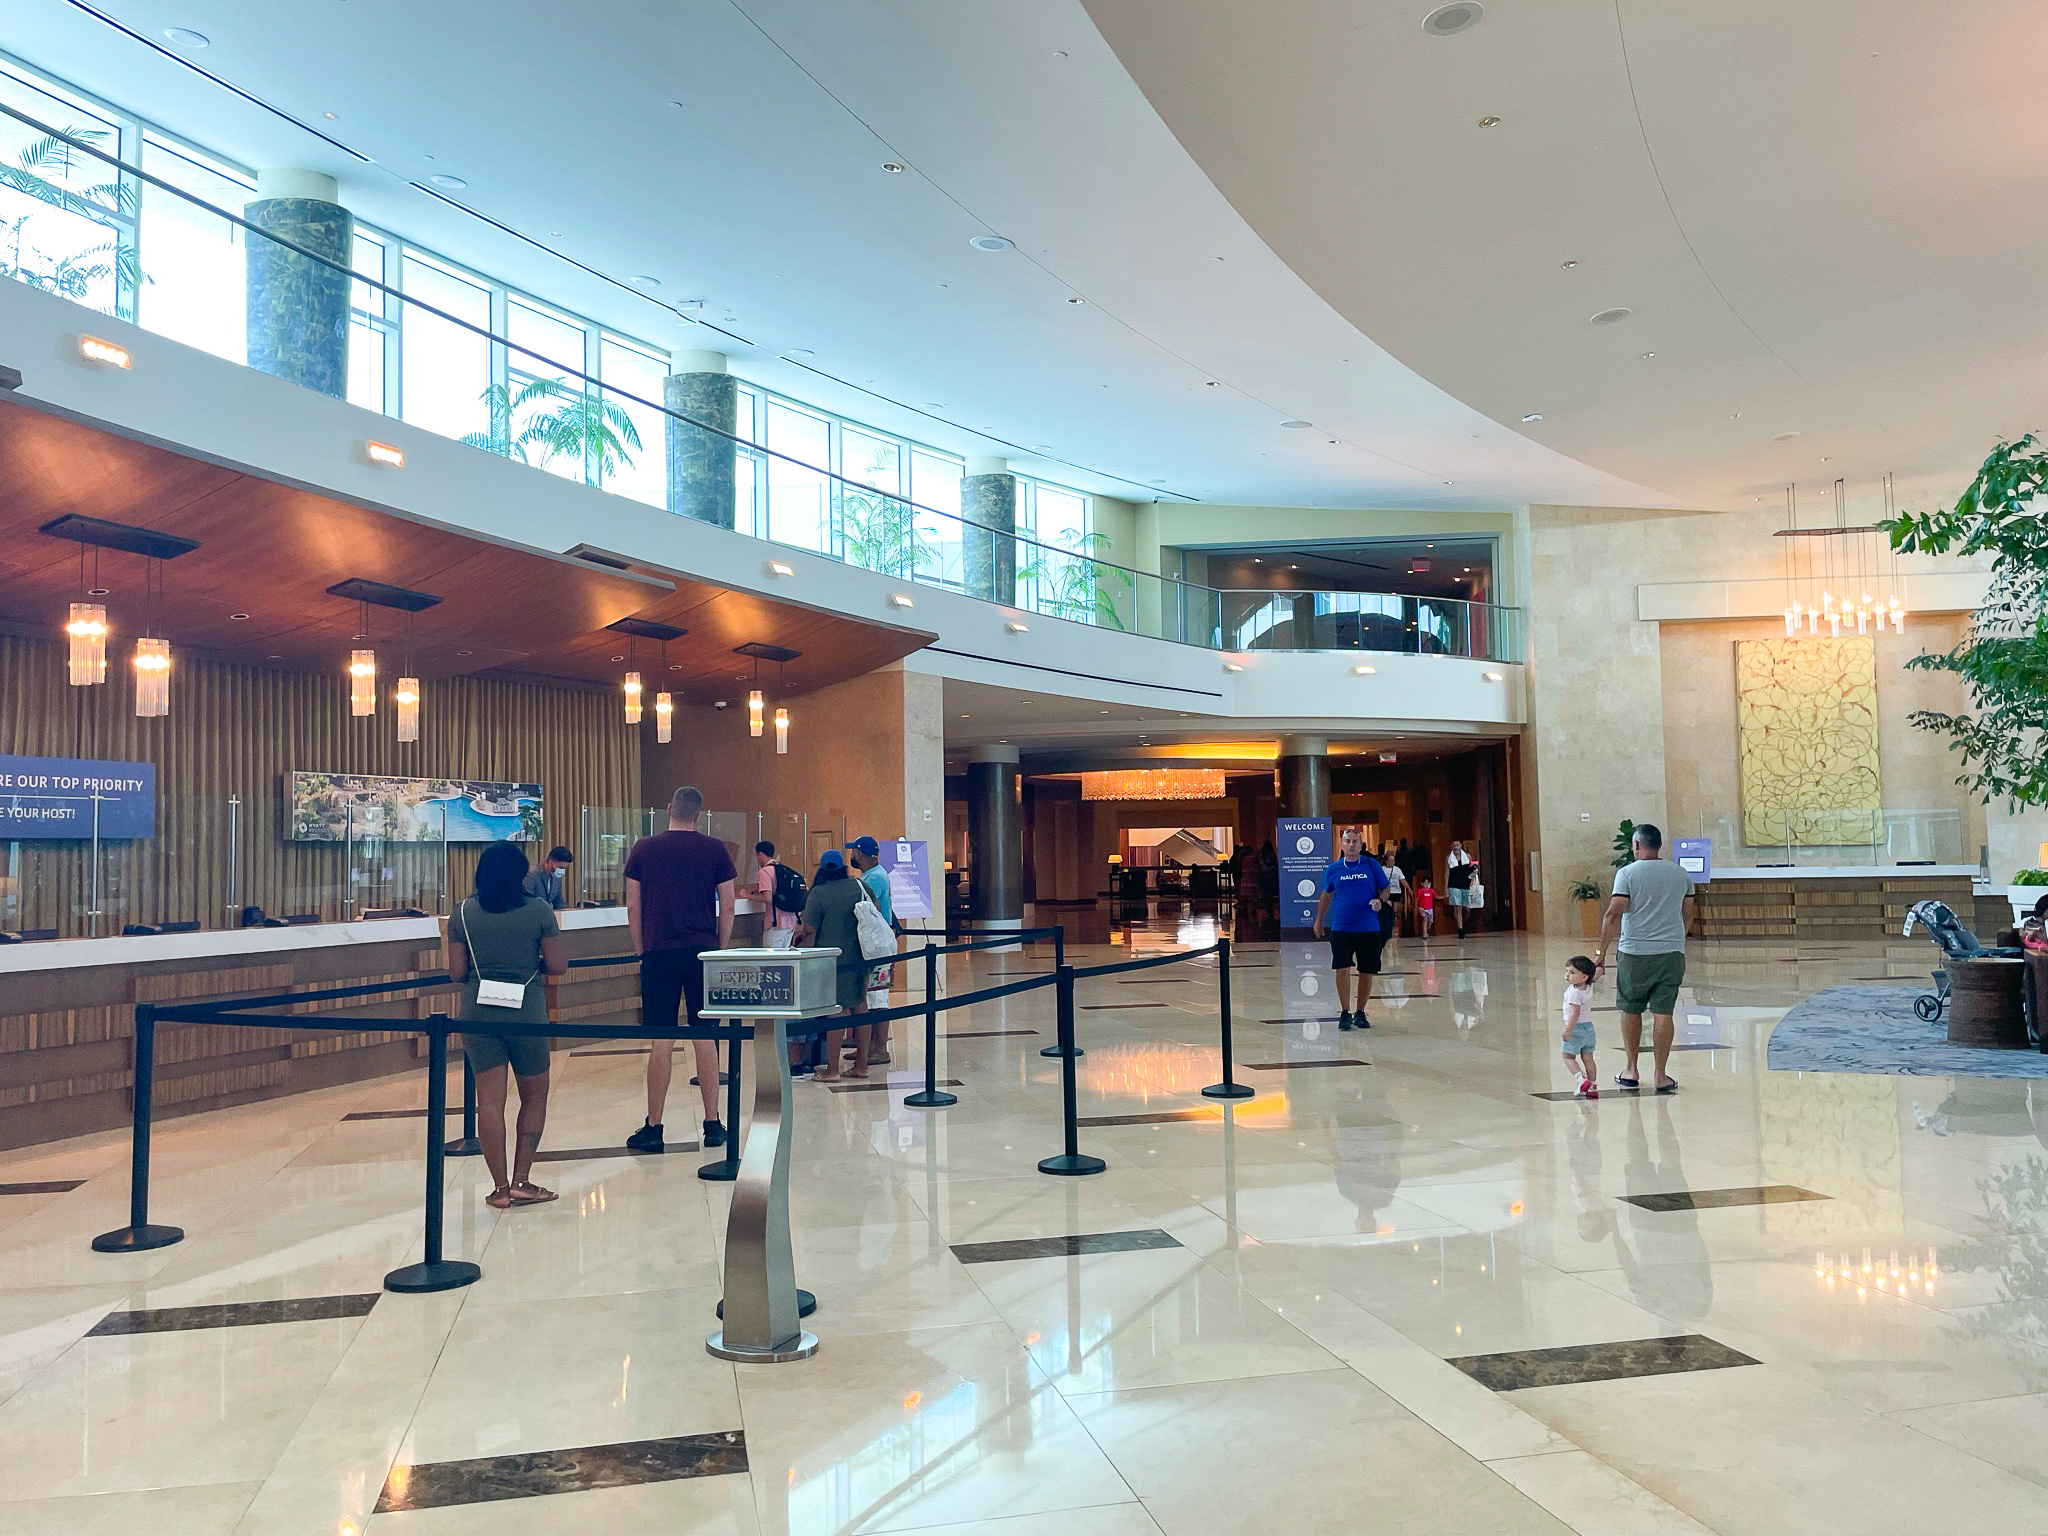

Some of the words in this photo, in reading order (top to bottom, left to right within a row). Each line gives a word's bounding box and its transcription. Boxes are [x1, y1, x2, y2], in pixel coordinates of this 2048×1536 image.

[17, 774, 48, 789] OUR
[52, 776, 80, 789] TOP
[83, 778, 144, 792] PRIORITY
[7, 807, 39, 819] YOUR
[42, 808, 76, 820] HOST!
[1284, 823, 1325, 831] WELCOME
[1340, 873, 1368, 881] NAUTICA
[719, 971, 782, 983] EXPRESS
